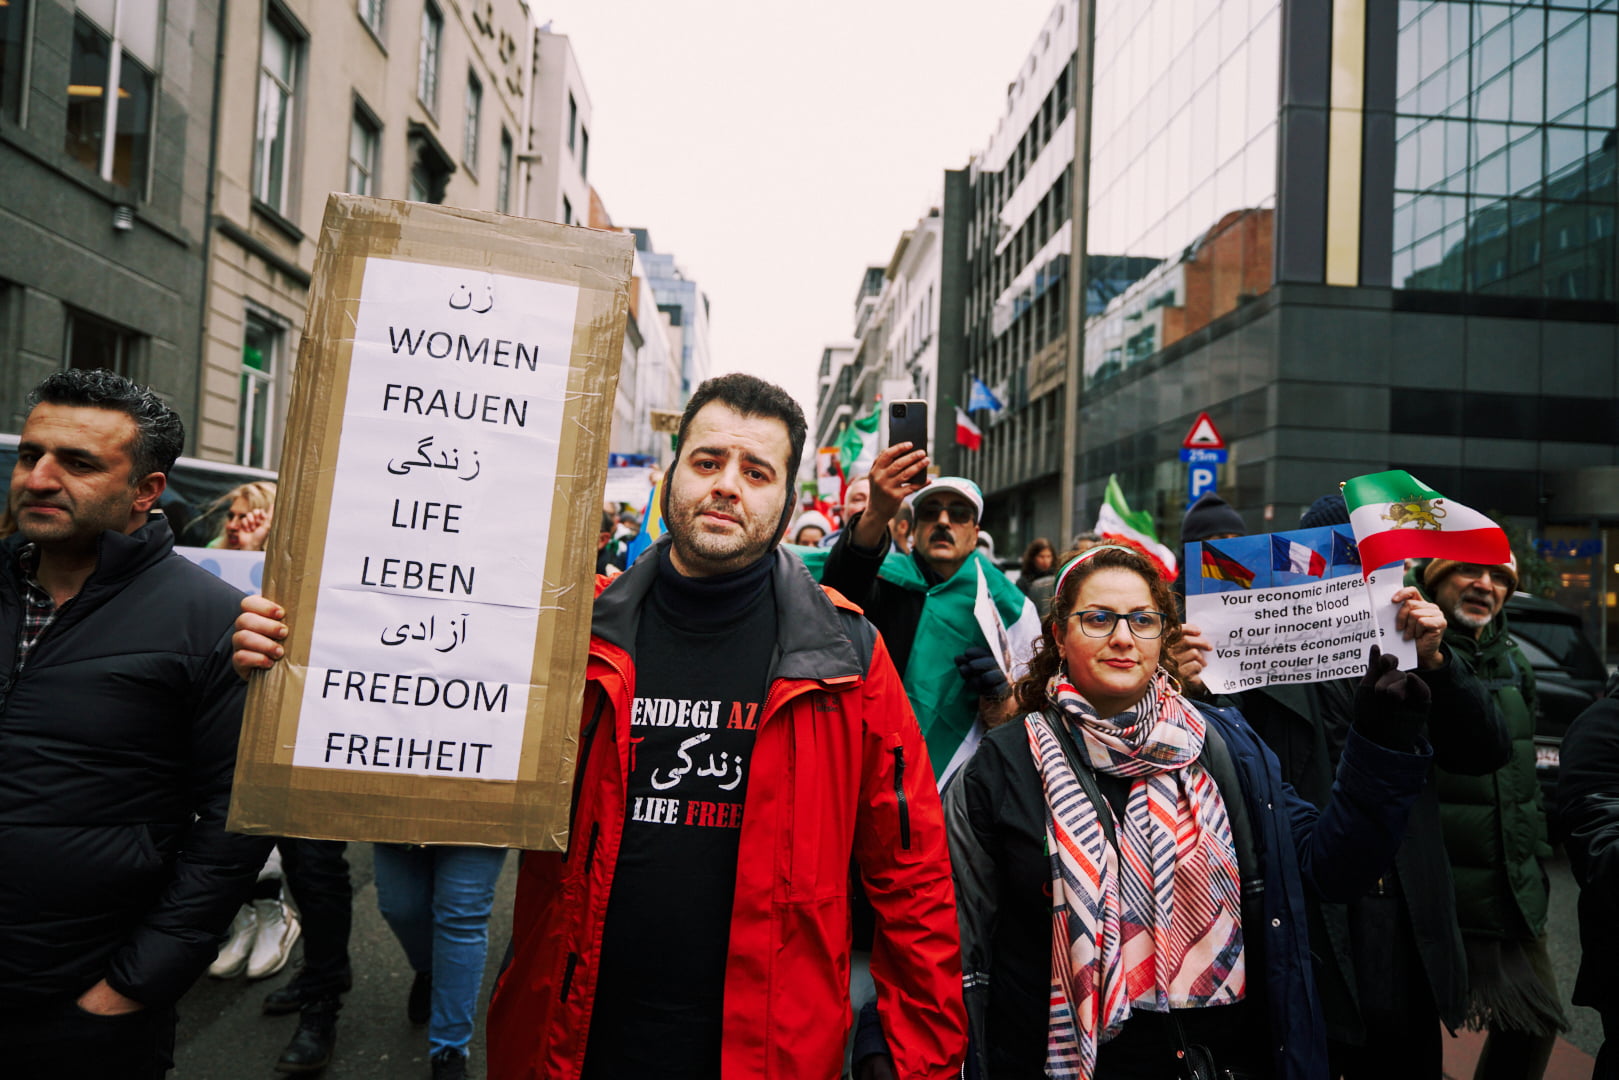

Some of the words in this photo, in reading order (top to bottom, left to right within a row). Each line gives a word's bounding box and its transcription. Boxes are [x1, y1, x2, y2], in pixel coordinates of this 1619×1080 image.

[448, 283, 494, 314] زن
[388, 326, 539, 372] WOMEN
[383, 383, 528, 428] FRAUEN
[387, 435, 480, 481] زندگی
[1189, 449, 1218, 461] 25m
[1192, 468, 1213, 497] P
[391, 498, 462, 534] LIFE
[361, 556, 475, 595] LEBEN
[1221, 594, 1253, 606] Your
[1256, 585, 1322, 603] economic
[1325, 575, 1376, 594] interess
[1254, 605, 1288, 620] shed
[1292, 604, 1313, 616] the
[1316, 595, 1349, 613] blood
[380, 613, 469, 653] آزادی
[1229, 627, 1243, 639] of
[1247, 626, 1270, 637] our
[1274, 616, 1332, 635] innocent
[1216, 648, 1241, 659] Vos
[1245, 642, 1297, 657] intérêts
[1300, 628, 1385, 652] économiques
[1240, 659, 1266, 671] font
[1270, 656, 1314, 669] couler
[1317, 654, 1328, 665] le
[1331, 648, 1362, 661] sang
[322, 668, 508, 713] FREEDOM
[1223, 680, 1236, 691] de
[1240, 675, 1263, 688] nos
[1265, 670, 1312, 686] jeunes
[324, 732, 493, 773] FREIHEIT
[651, 732, 743, 791] زندگی
[631, 796, 680, 825] LIFE
